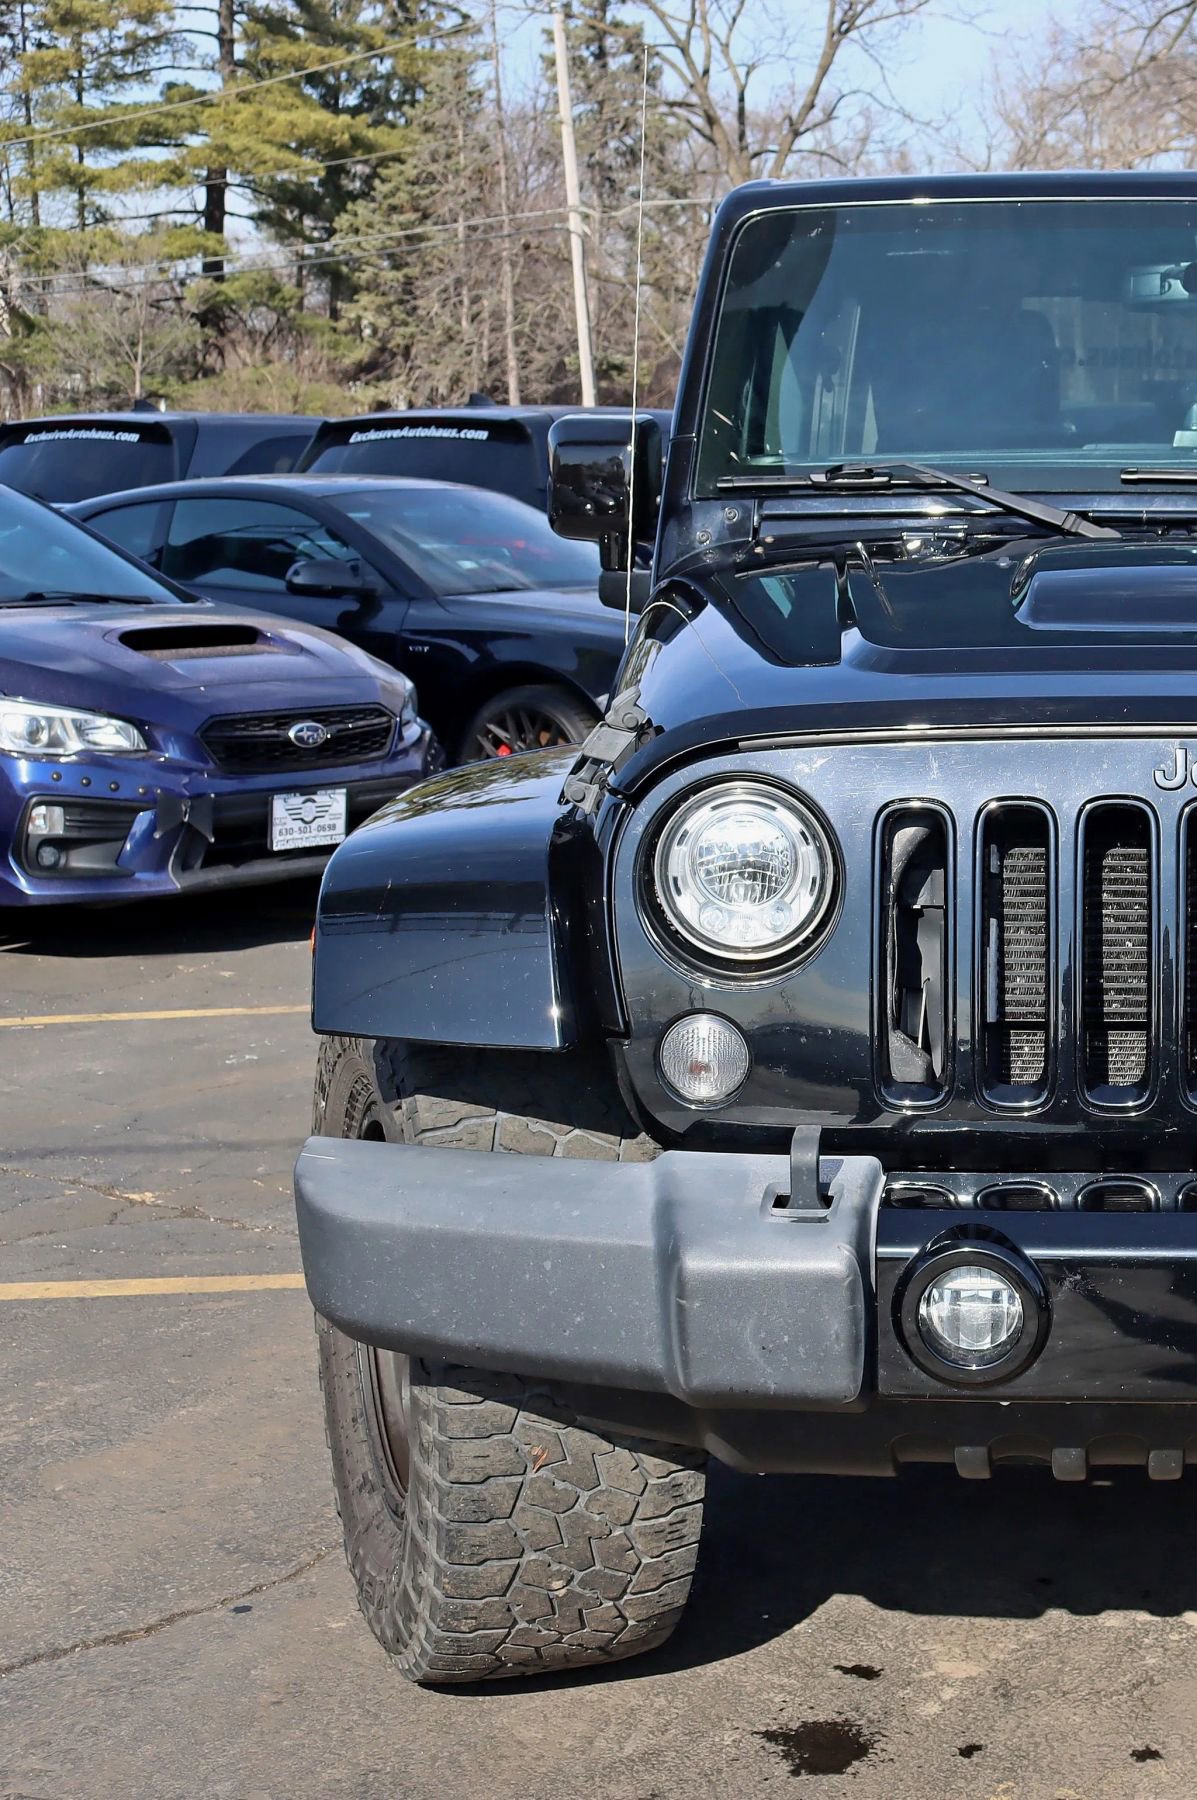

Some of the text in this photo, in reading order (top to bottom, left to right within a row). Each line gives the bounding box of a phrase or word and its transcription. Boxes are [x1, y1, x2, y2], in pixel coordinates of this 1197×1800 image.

[24, 428, 140, 444] ExclusiveAutohaus.com
[349, 425, 489, 444] ExclusiveAutohaus.com
[278, 823, 337, 837] 630-501-0698
